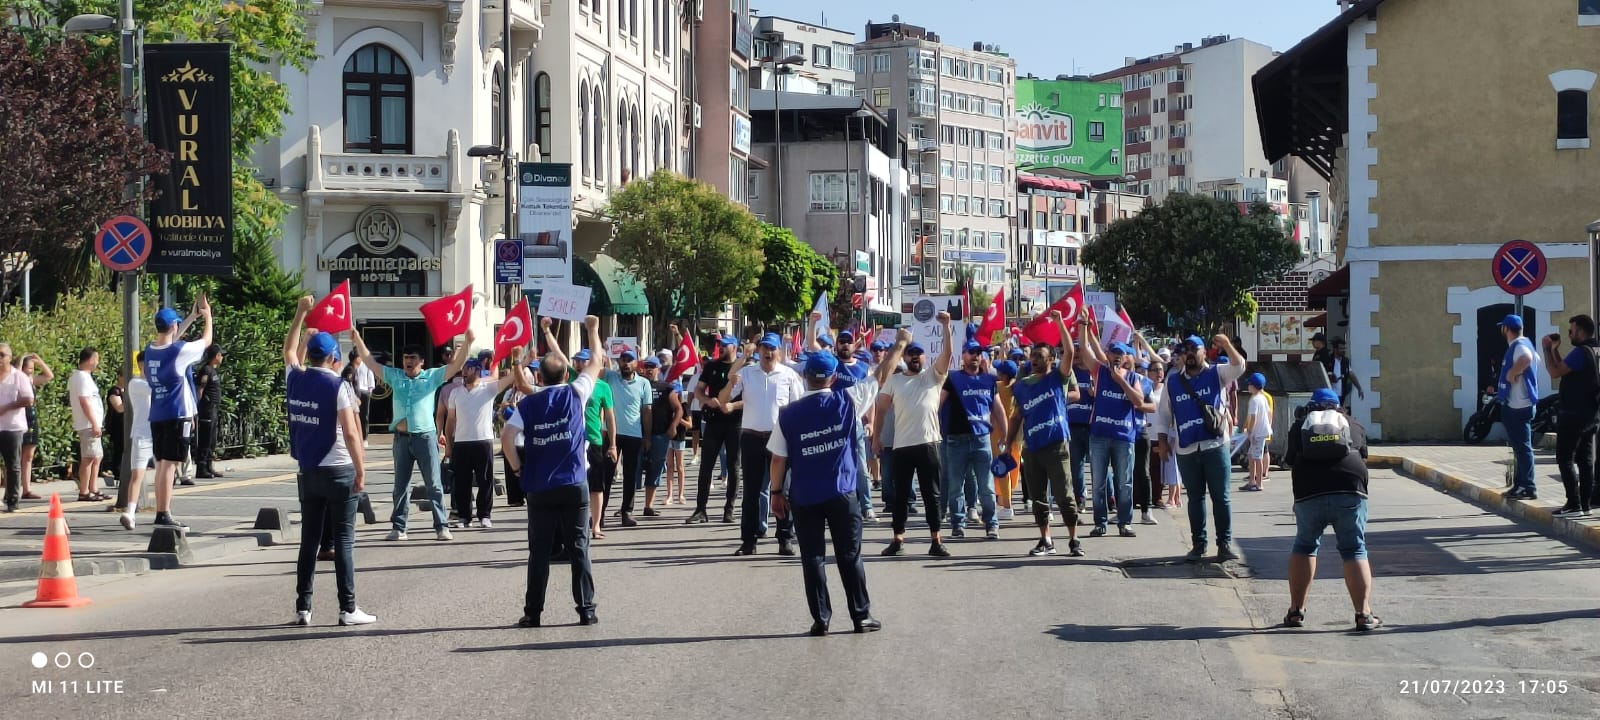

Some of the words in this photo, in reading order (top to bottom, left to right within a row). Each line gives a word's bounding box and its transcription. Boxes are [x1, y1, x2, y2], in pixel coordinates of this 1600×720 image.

[178, 88, 200, 210] VURAL
[1053, 154, 1084, 166] güven
[360, 273, 400, 282] HOTEL
[1310, 433, 1340, 443] adidas
